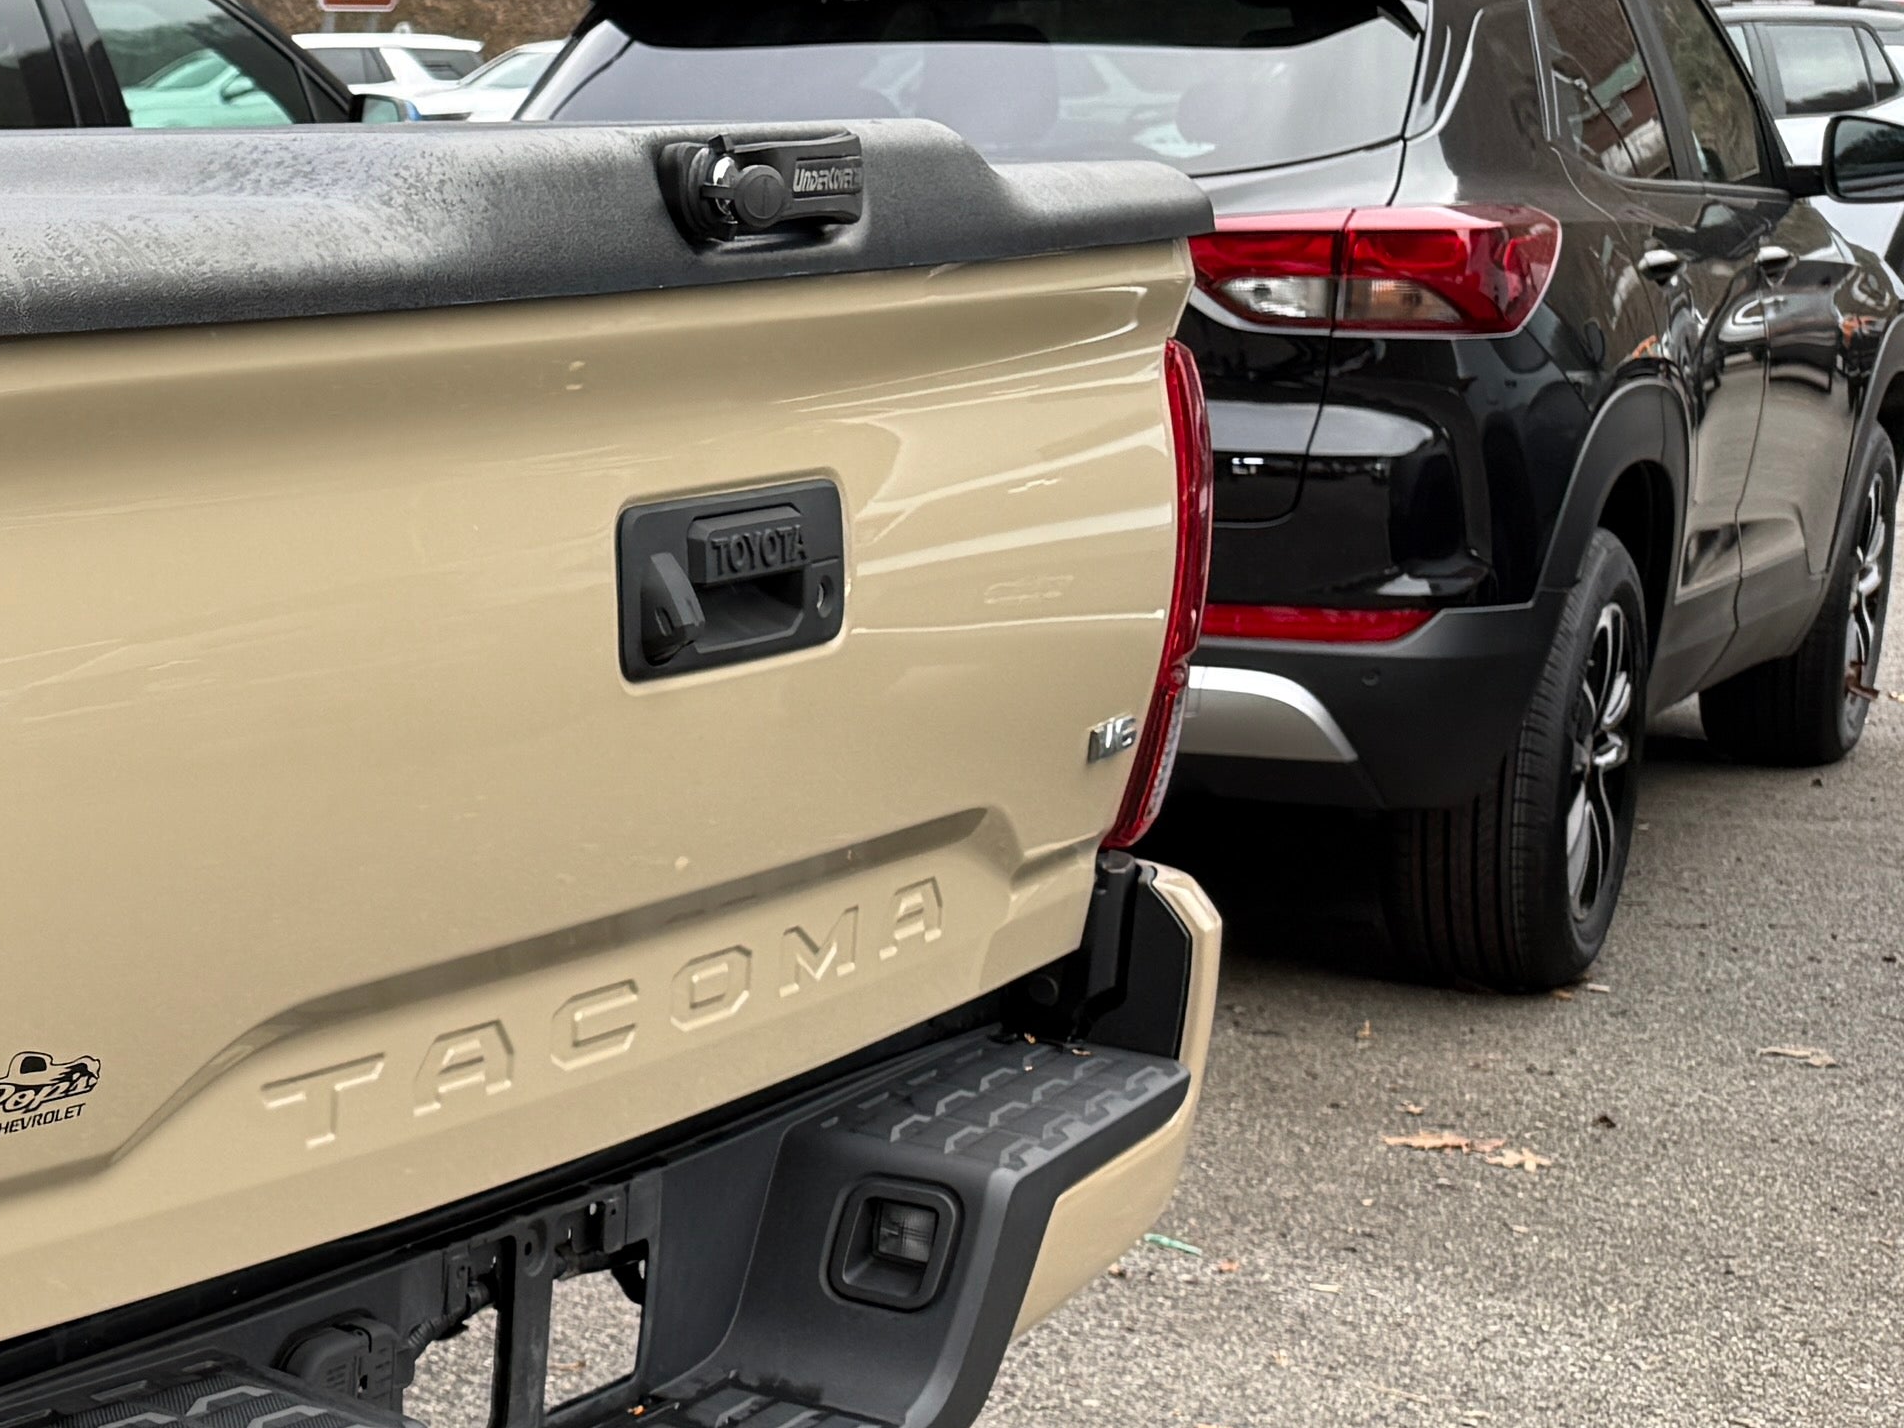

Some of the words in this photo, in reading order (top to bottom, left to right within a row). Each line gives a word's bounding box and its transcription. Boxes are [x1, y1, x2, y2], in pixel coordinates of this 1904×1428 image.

[710, 523, 808, 577] TOYOTA
[1087, 712, 1137, 764] V6
[258, 876, 946, 1150] TACOMA
